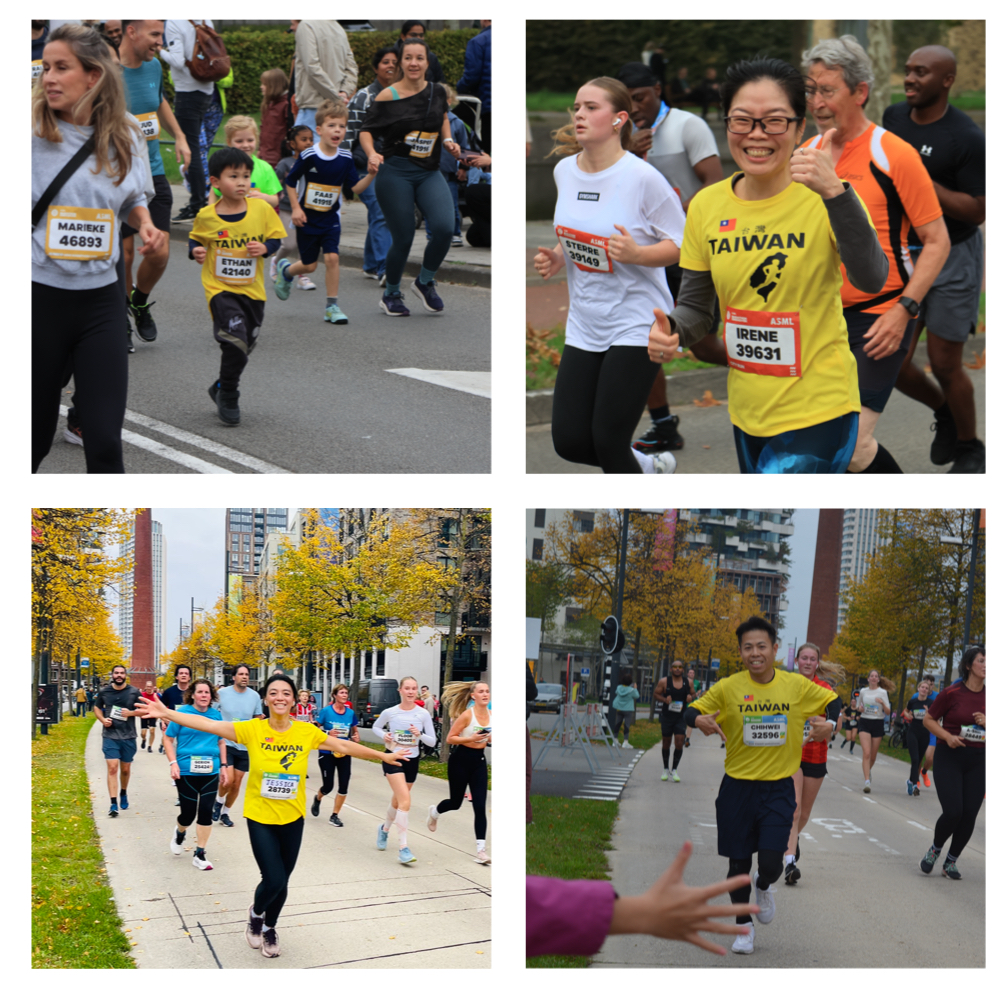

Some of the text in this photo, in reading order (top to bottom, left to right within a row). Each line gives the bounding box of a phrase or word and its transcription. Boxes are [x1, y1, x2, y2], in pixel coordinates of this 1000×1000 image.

[57, 222, 106, 234] MARIEKE
[59, 236, 103, 248] 46893
[590, 238, 607, 247] ASML
[708, 232, 806, 256] TAIWAN
[565, 240, 600, 257] STERRE
[221, 258, 252, 267] ETHAN
[569, 251, 600, 268] 39149
[221, 267, 252, 277] 42140
[770, 317, 794, 326] ASML
[735, 328, 778, 343] IRENE
[735, 343, 781, 361] 39631
[737, 703, 790, 713] TAIWAN
[260, 742, 304, 752] TAIWAN
